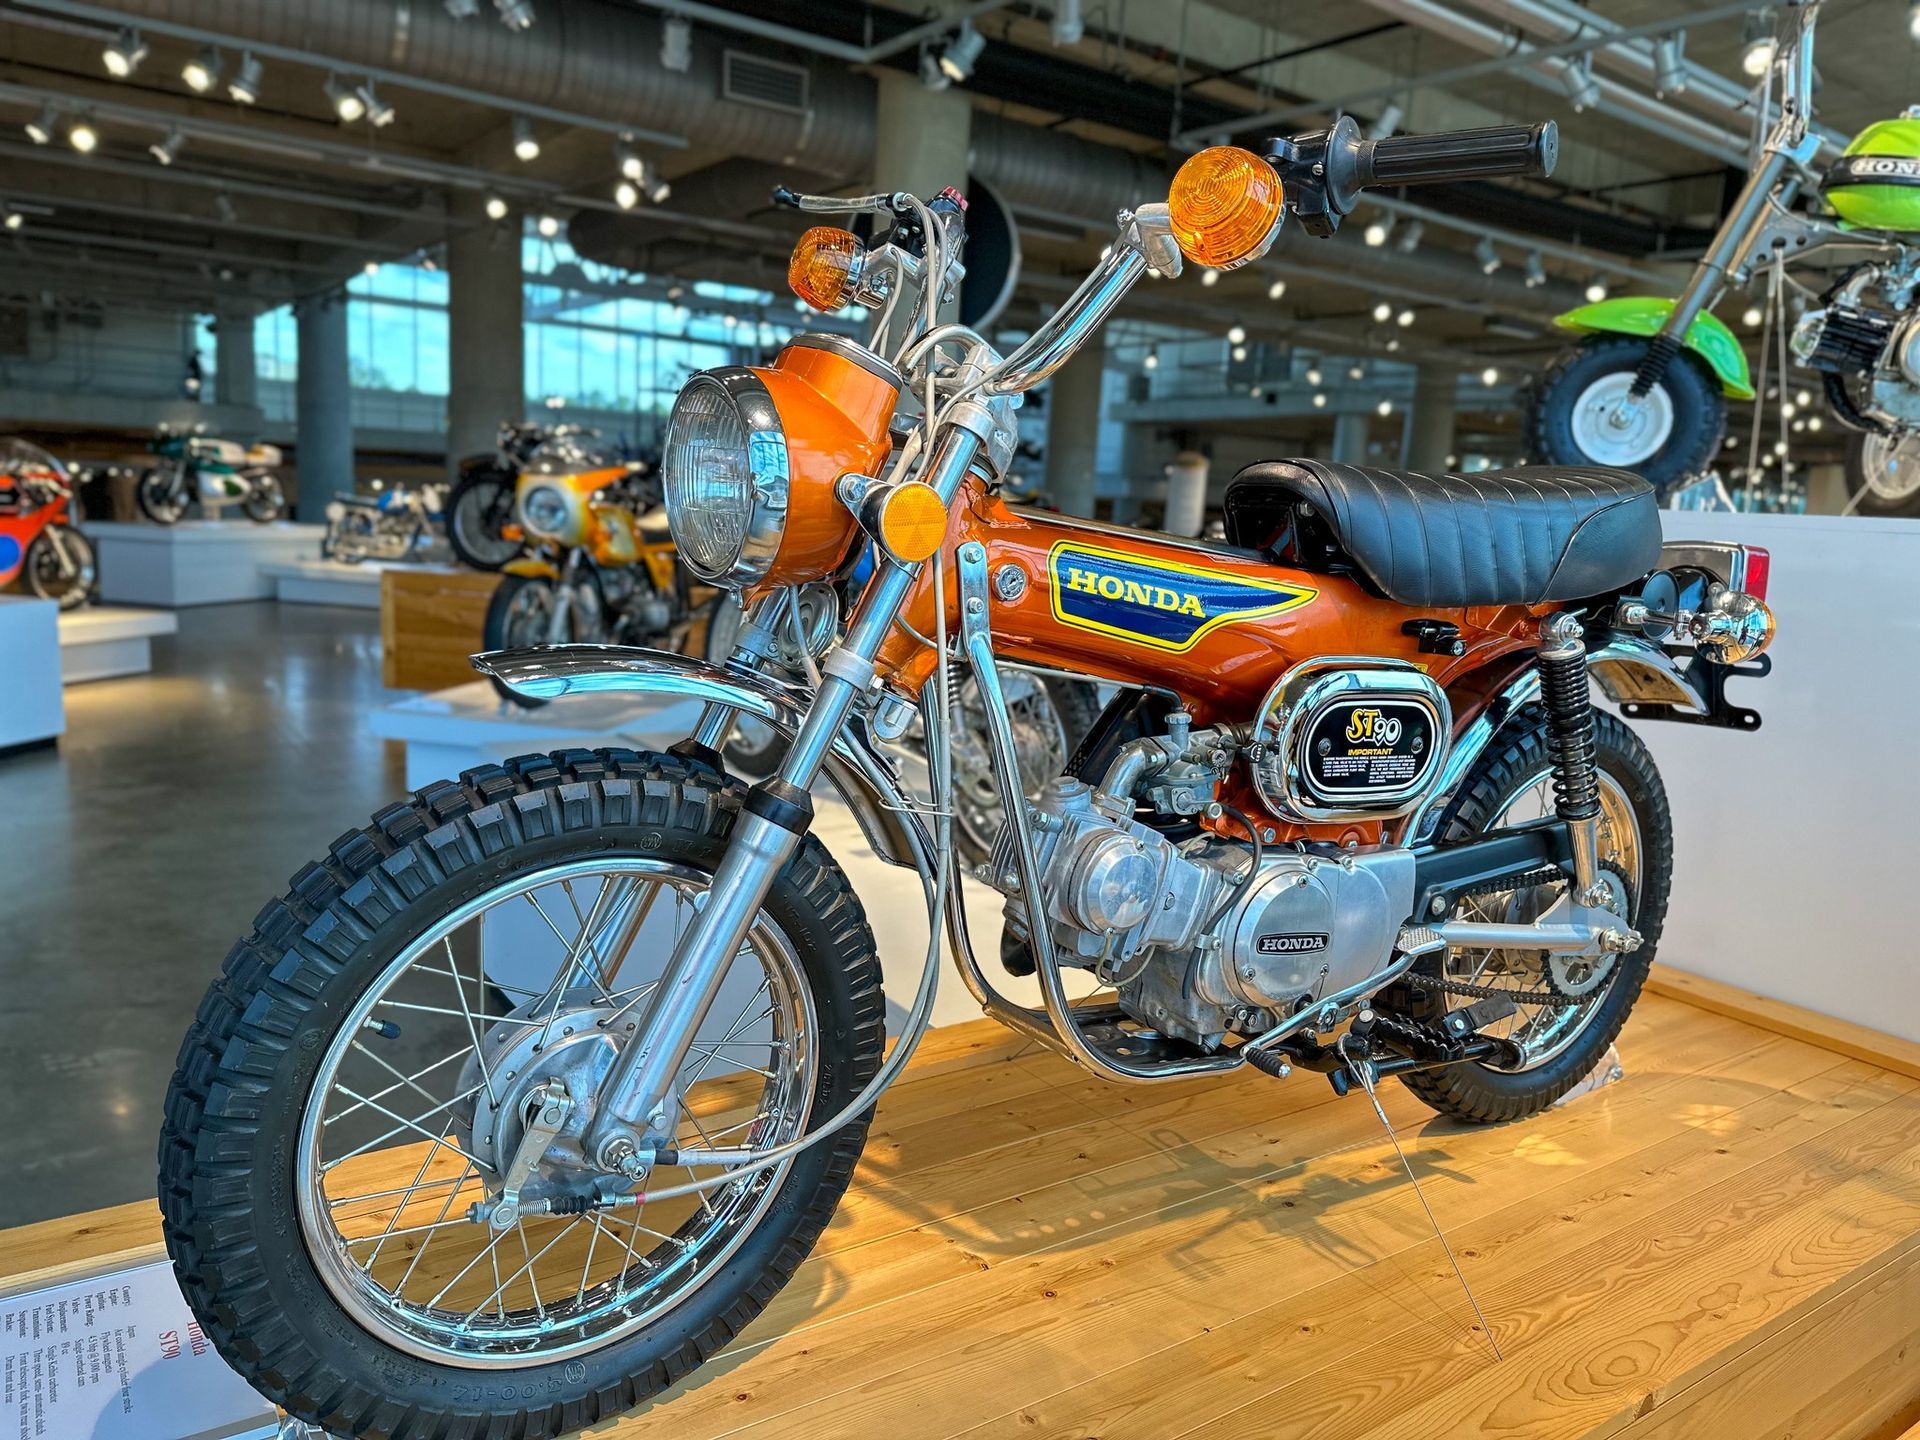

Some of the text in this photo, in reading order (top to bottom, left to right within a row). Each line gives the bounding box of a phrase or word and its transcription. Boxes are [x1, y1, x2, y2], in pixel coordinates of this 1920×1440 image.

[1856, 160, 1920, 174] HON
[1066, 567, 1206, 618] HONDA
[1346, 709, 1402, 746] ST90
[1348, 748, 1393, 756] IMPORTANT
[1262, 937, 1324, 950] HONDA
[159, 1330, 181, 1360] ST90
